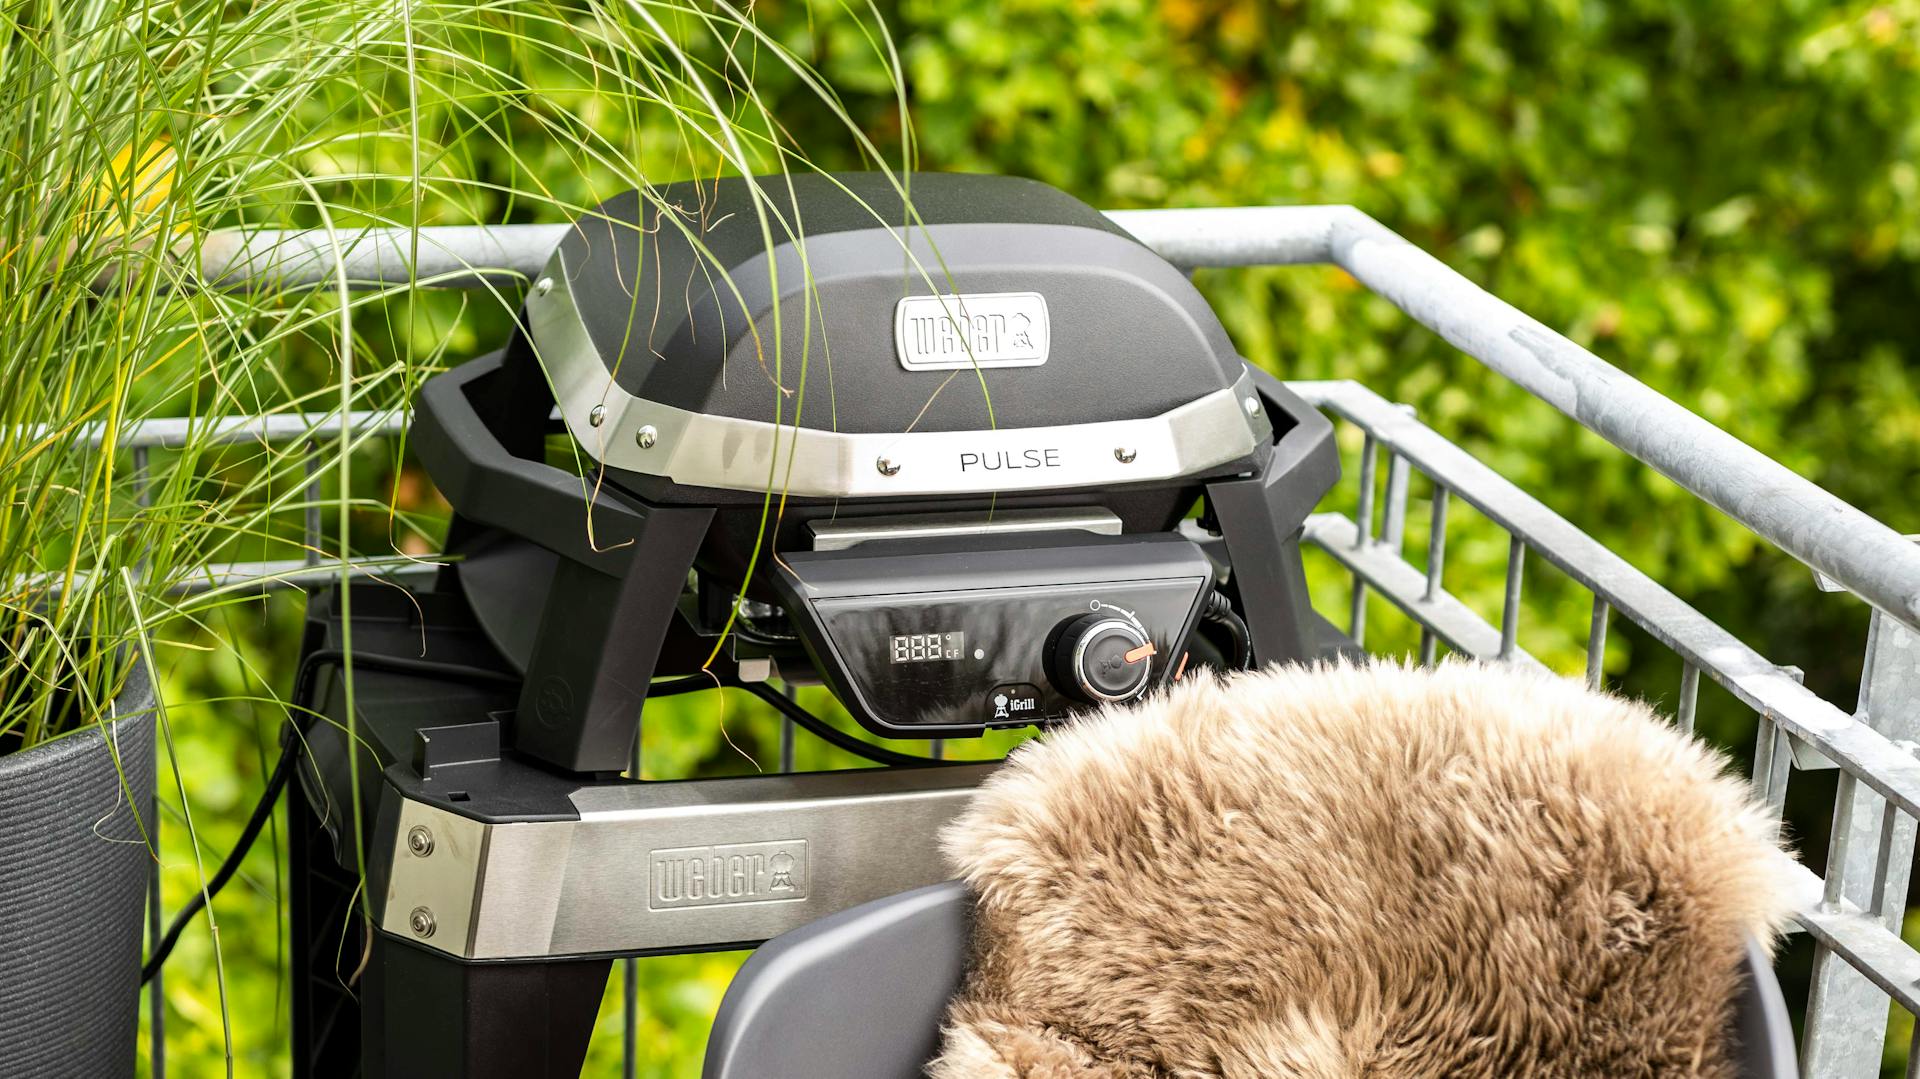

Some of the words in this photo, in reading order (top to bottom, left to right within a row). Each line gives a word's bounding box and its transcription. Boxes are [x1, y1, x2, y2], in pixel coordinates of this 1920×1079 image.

[960, 448, 1061, 472] PULSE
[894, 633, 942, 662] 888
[1009, 698, 1035, 711] iGrill
[656, 848, 765, 902] weber
